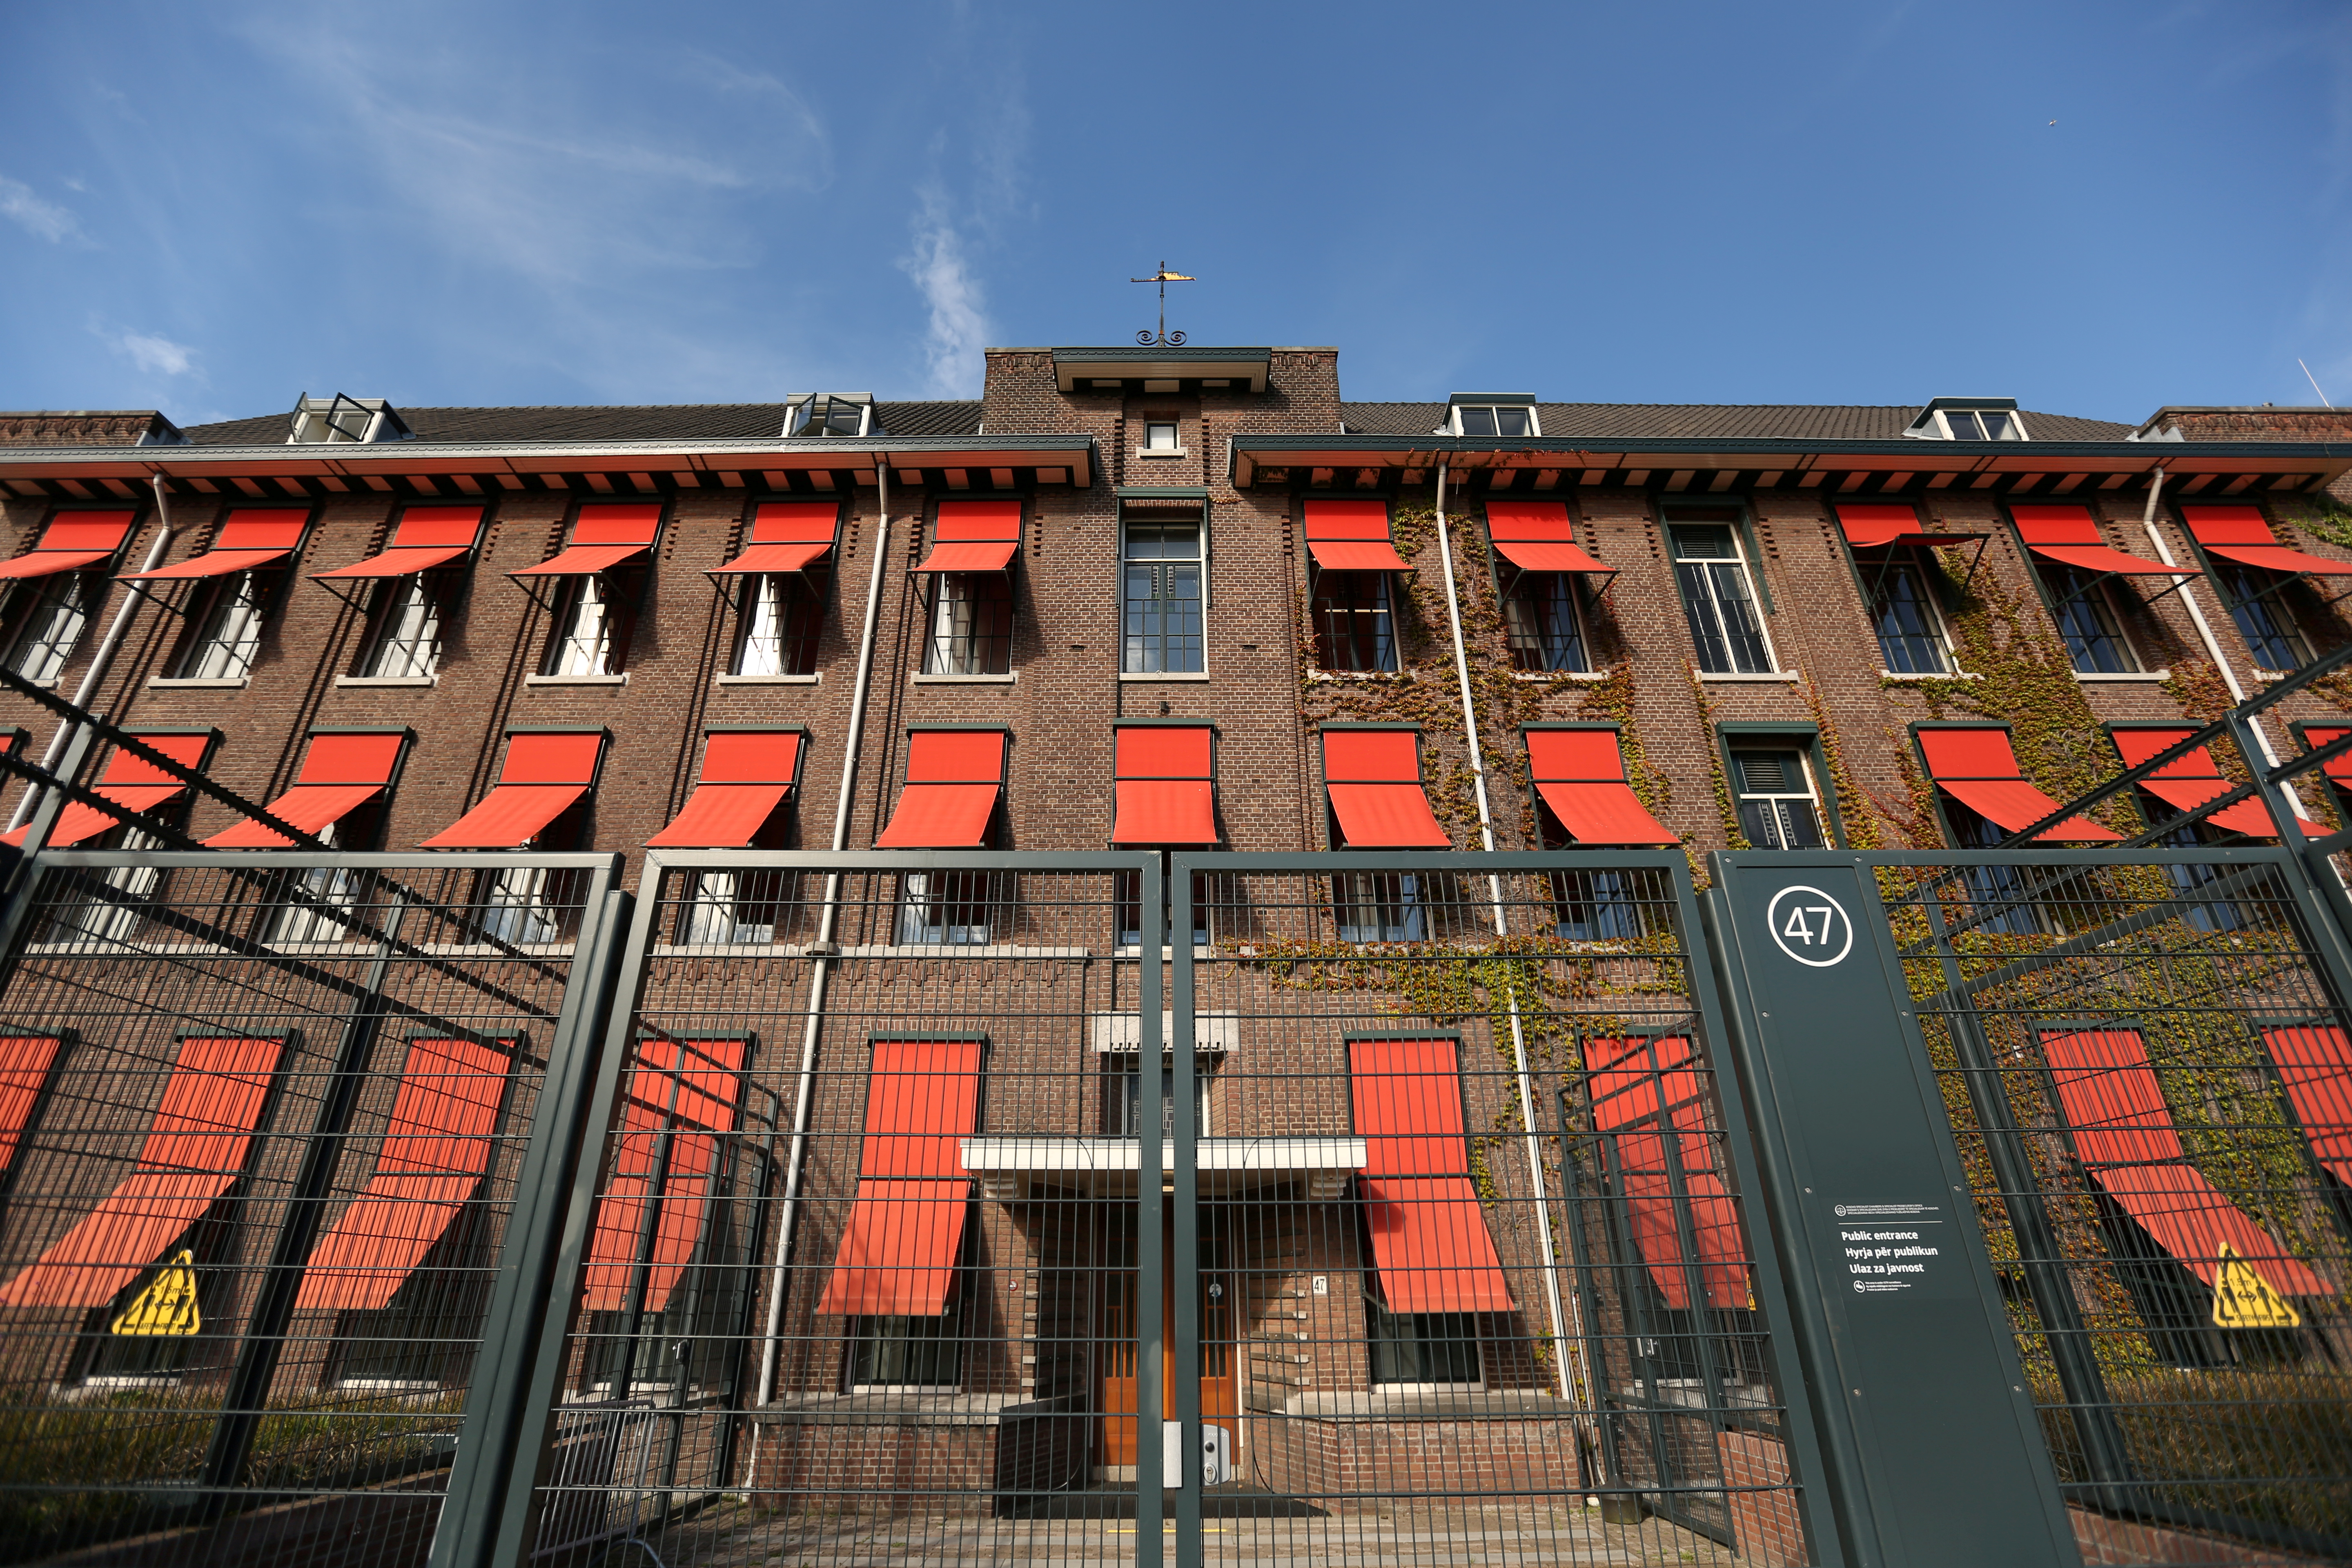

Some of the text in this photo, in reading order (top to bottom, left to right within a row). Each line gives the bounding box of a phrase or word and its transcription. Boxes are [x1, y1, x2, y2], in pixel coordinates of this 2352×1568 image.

[1784, 906, 1833, 945] 47
[1841, 1231, 1919, 1241] Public entrance
[1845, 1246, 1938, 1259] Hyrja për publikun
[1849, 1264, 1873, 1274] Ulaz
[1886, 1263, 1924, 1275] javnost
[1314, 1278, 1325, 1291] 47
